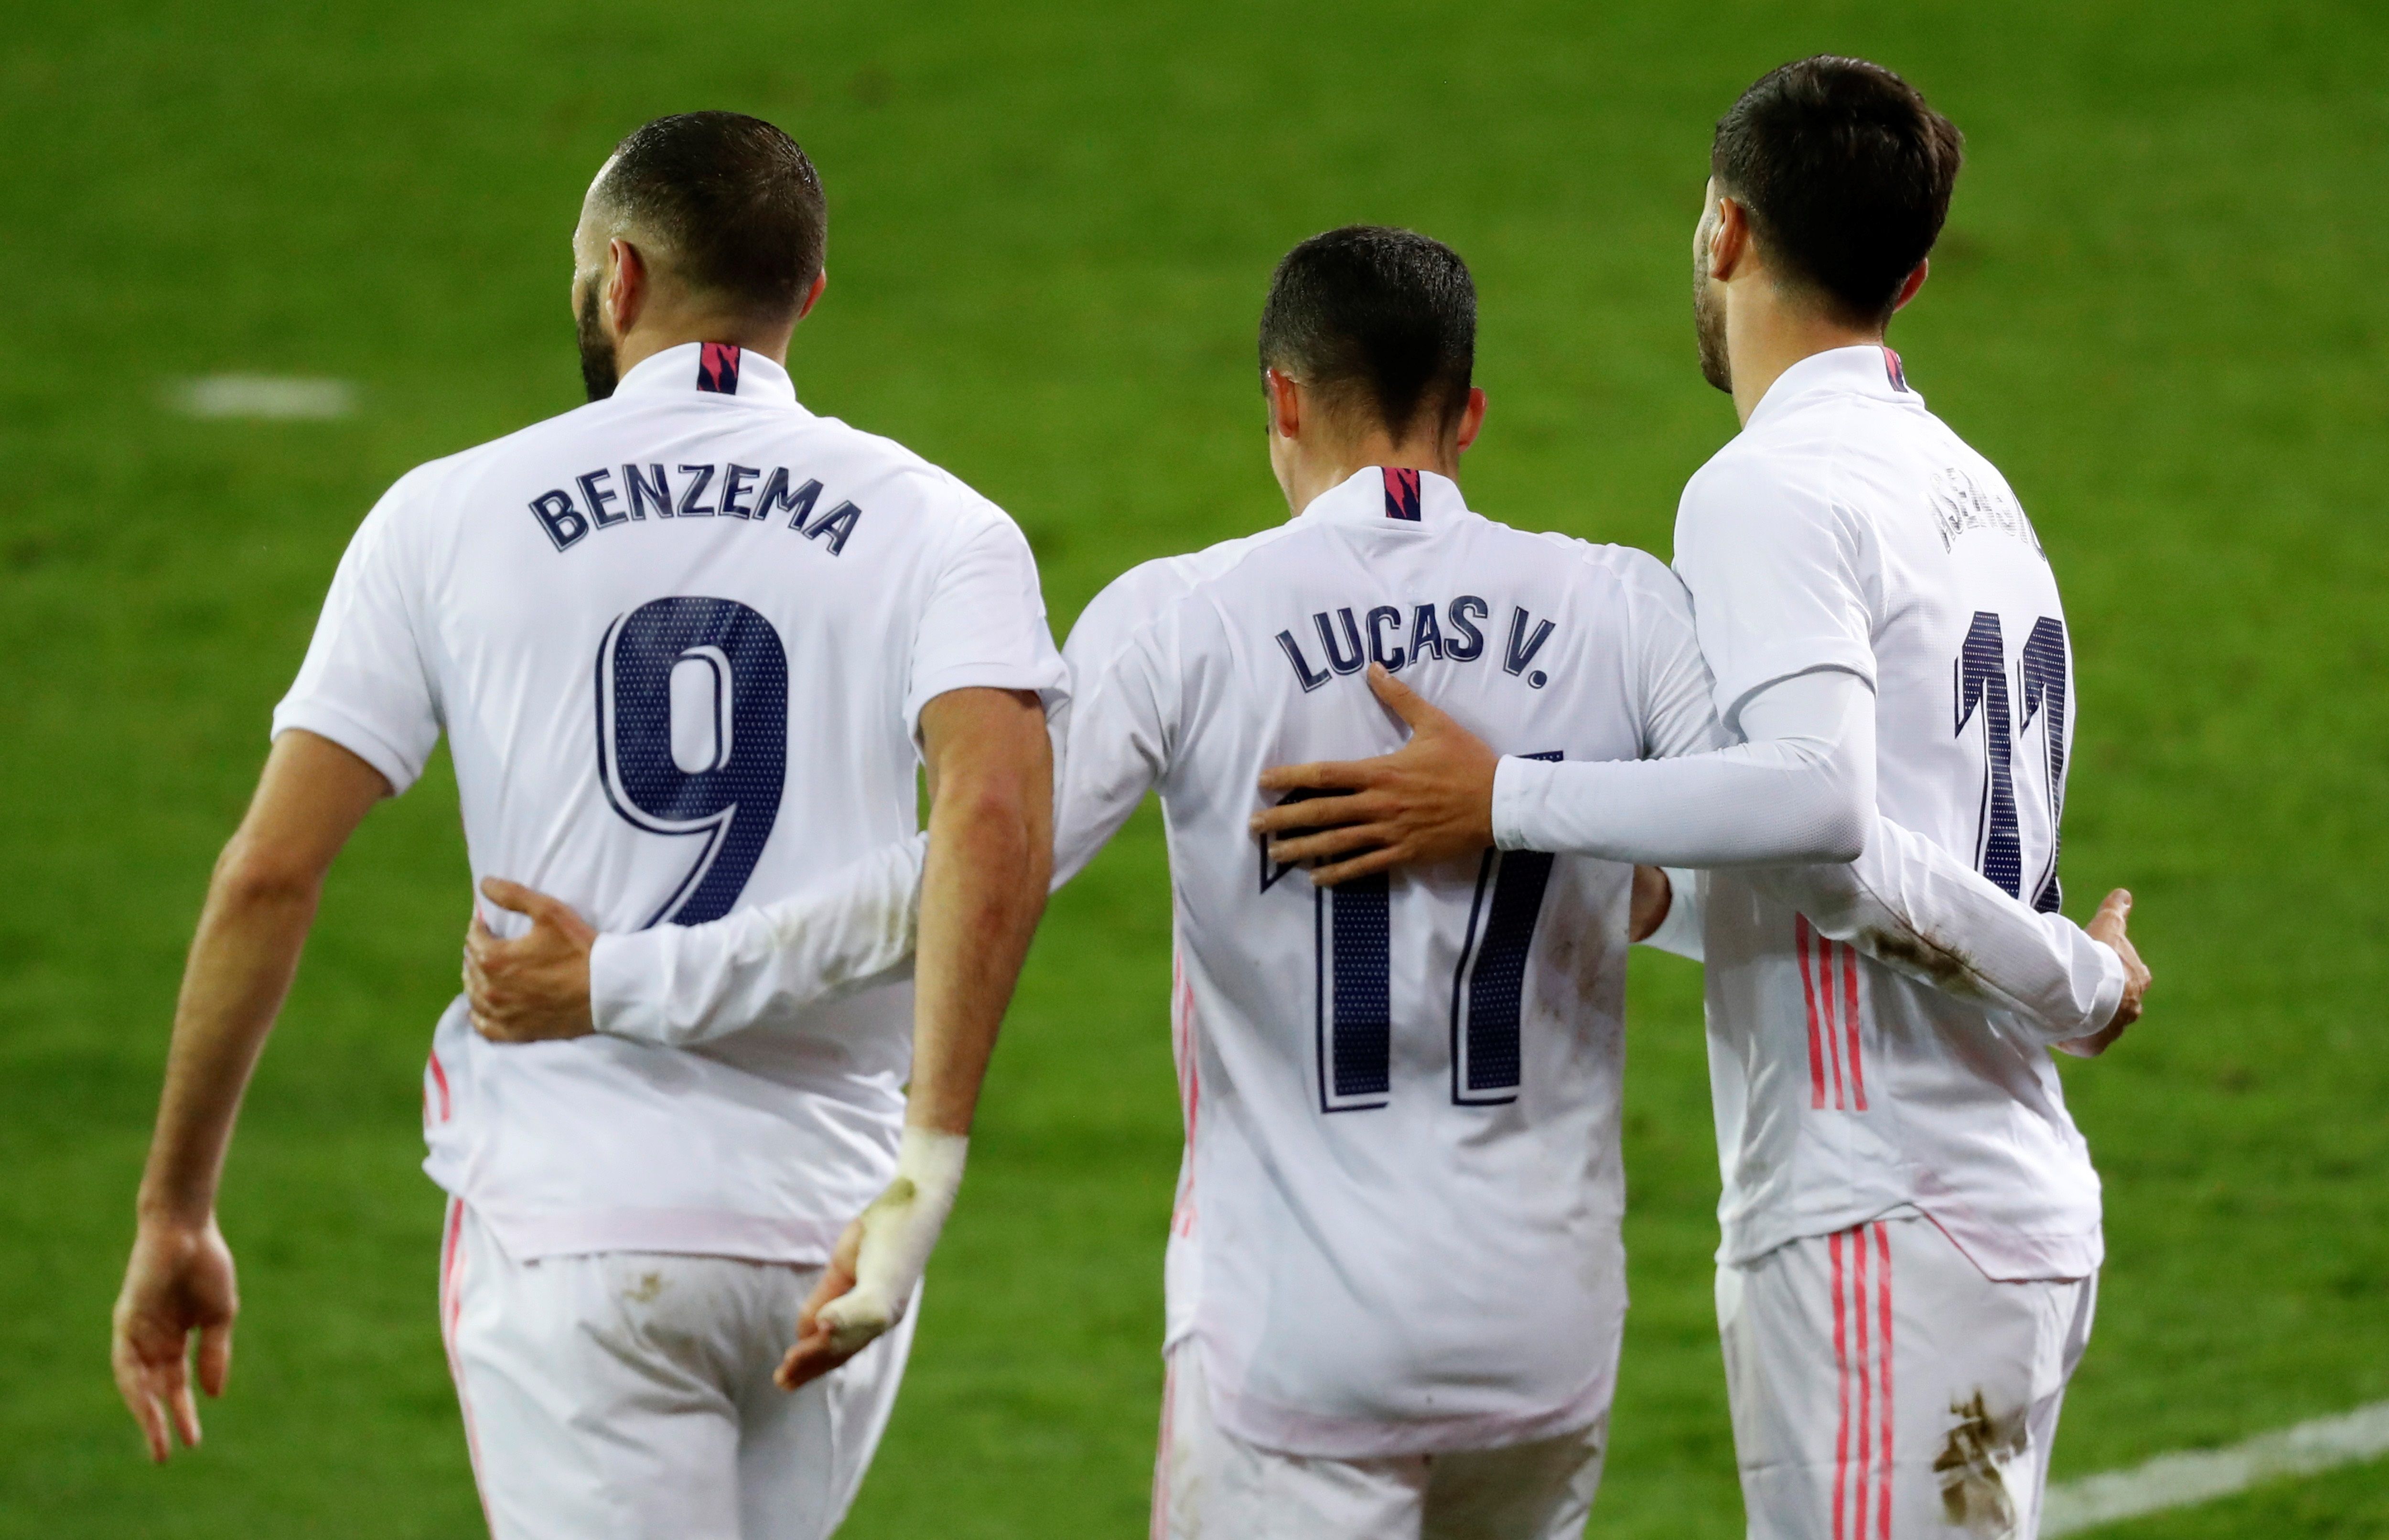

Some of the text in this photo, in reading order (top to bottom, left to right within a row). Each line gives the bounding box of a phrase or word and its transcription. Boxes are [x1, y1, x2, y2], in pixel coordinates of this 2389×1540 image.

[528, 463, 861, 556] BENZEMA
[1274, 595, 1556, 693] LUCAS V.
[594, 596, 788, 931] 9
[1954, 611, 2066, 914] 11
[1260, 750, 1564, 1114] 17
